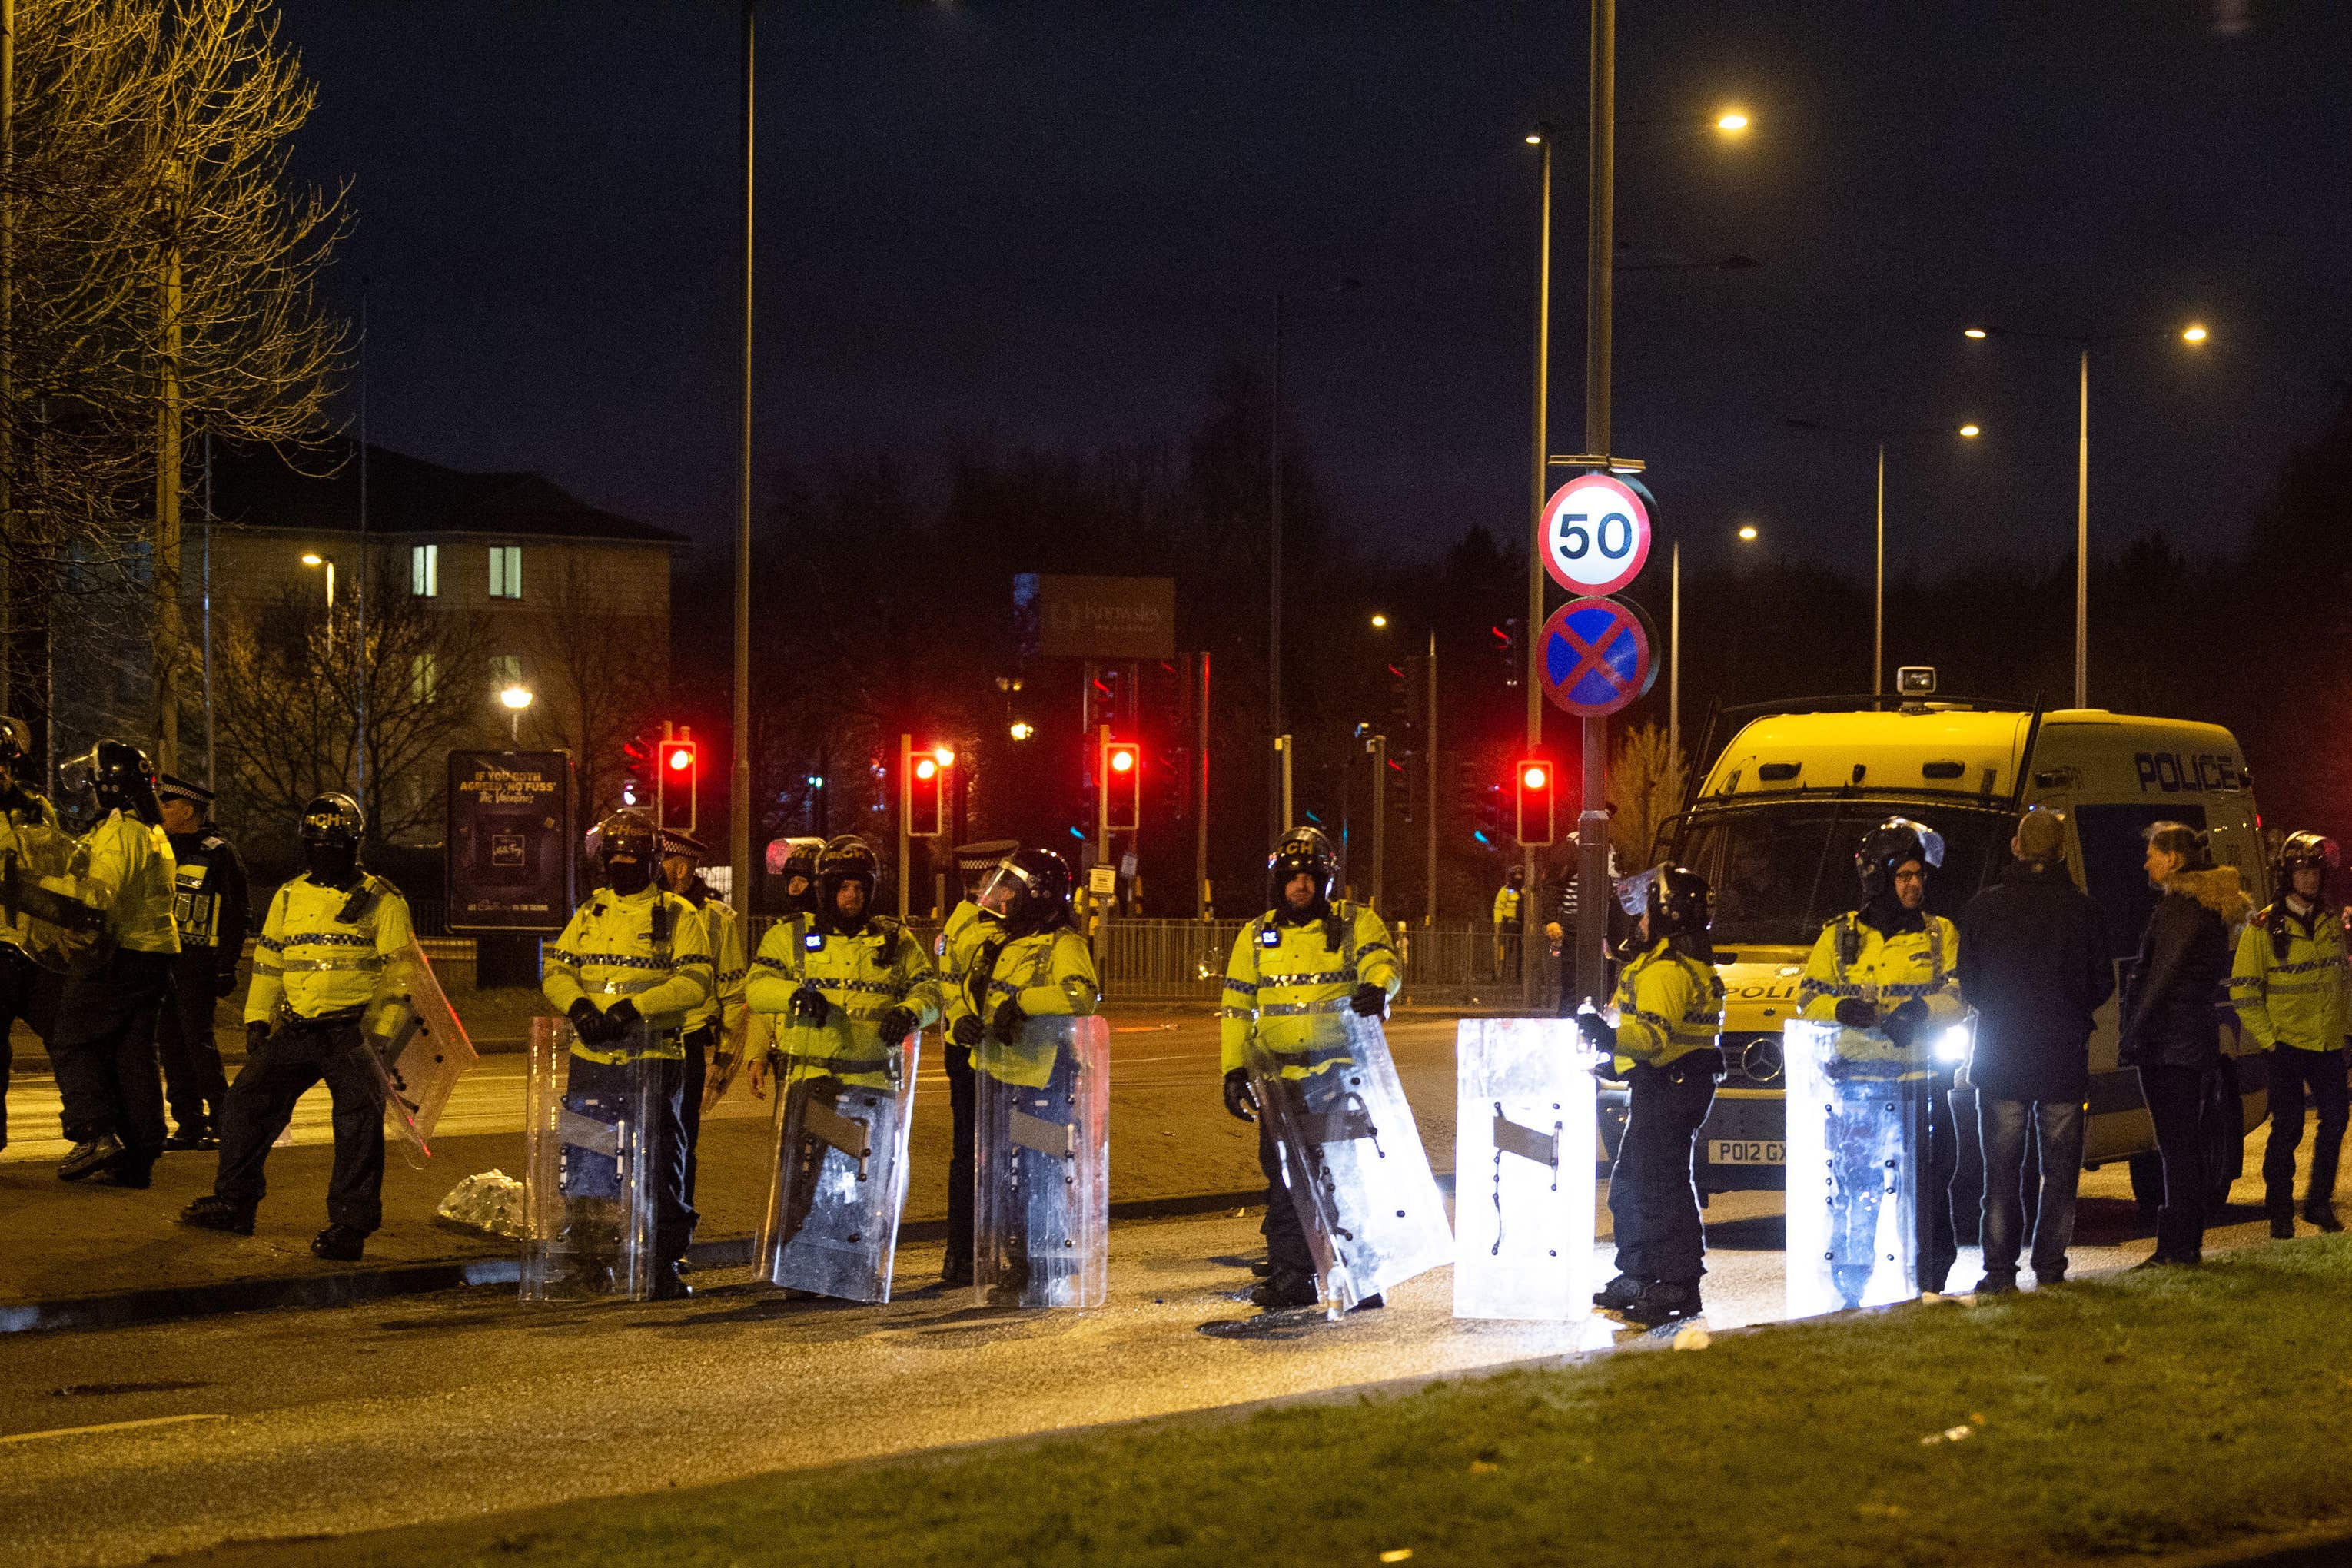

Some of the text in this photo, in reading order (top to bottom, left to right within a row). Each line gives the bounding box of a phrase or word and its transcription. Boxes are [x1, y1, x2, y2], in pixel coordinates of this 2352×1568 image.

[1560, 513, 1632, 560] 50
[475, 771, 485, 782] IF
[2135, 752, 2240, 792] POLICE
[1726, 986, 1796, 998] POLI
[1720, 1143, 1760, 1161] PO12
